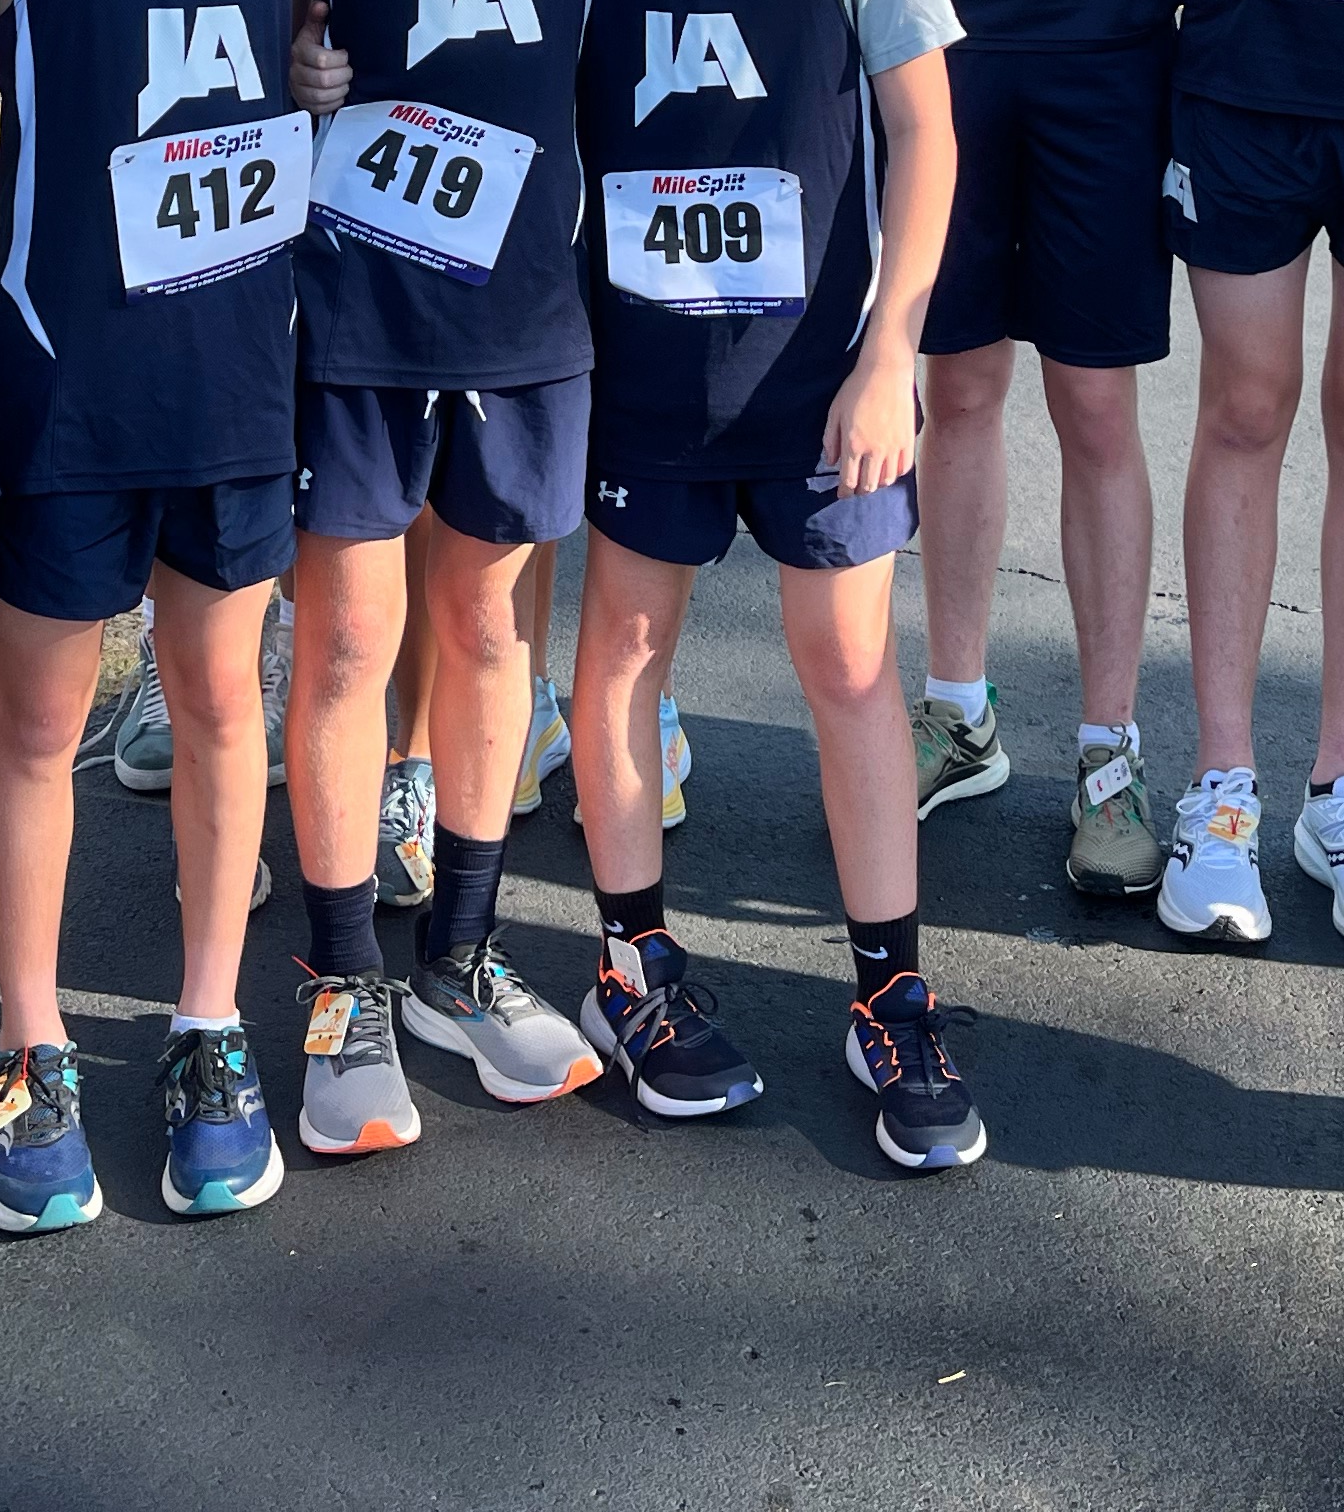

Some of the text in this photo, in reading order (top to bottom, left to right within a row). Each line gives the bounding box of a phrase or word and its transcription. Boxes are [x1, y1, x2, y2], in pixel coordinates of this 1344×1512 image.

[138, 4, 265, 138] JA
[635, 10, 768, 127] JA
[164, 128, 263, 163] MileSplit
[389, 104, 486, 148] MileSplit
[156, 159, 276, 239] 412
[356, 129, 484, 219] 419
[652, 173, 746, 196] MileSplit
[643, 201, 763, 264] 409
